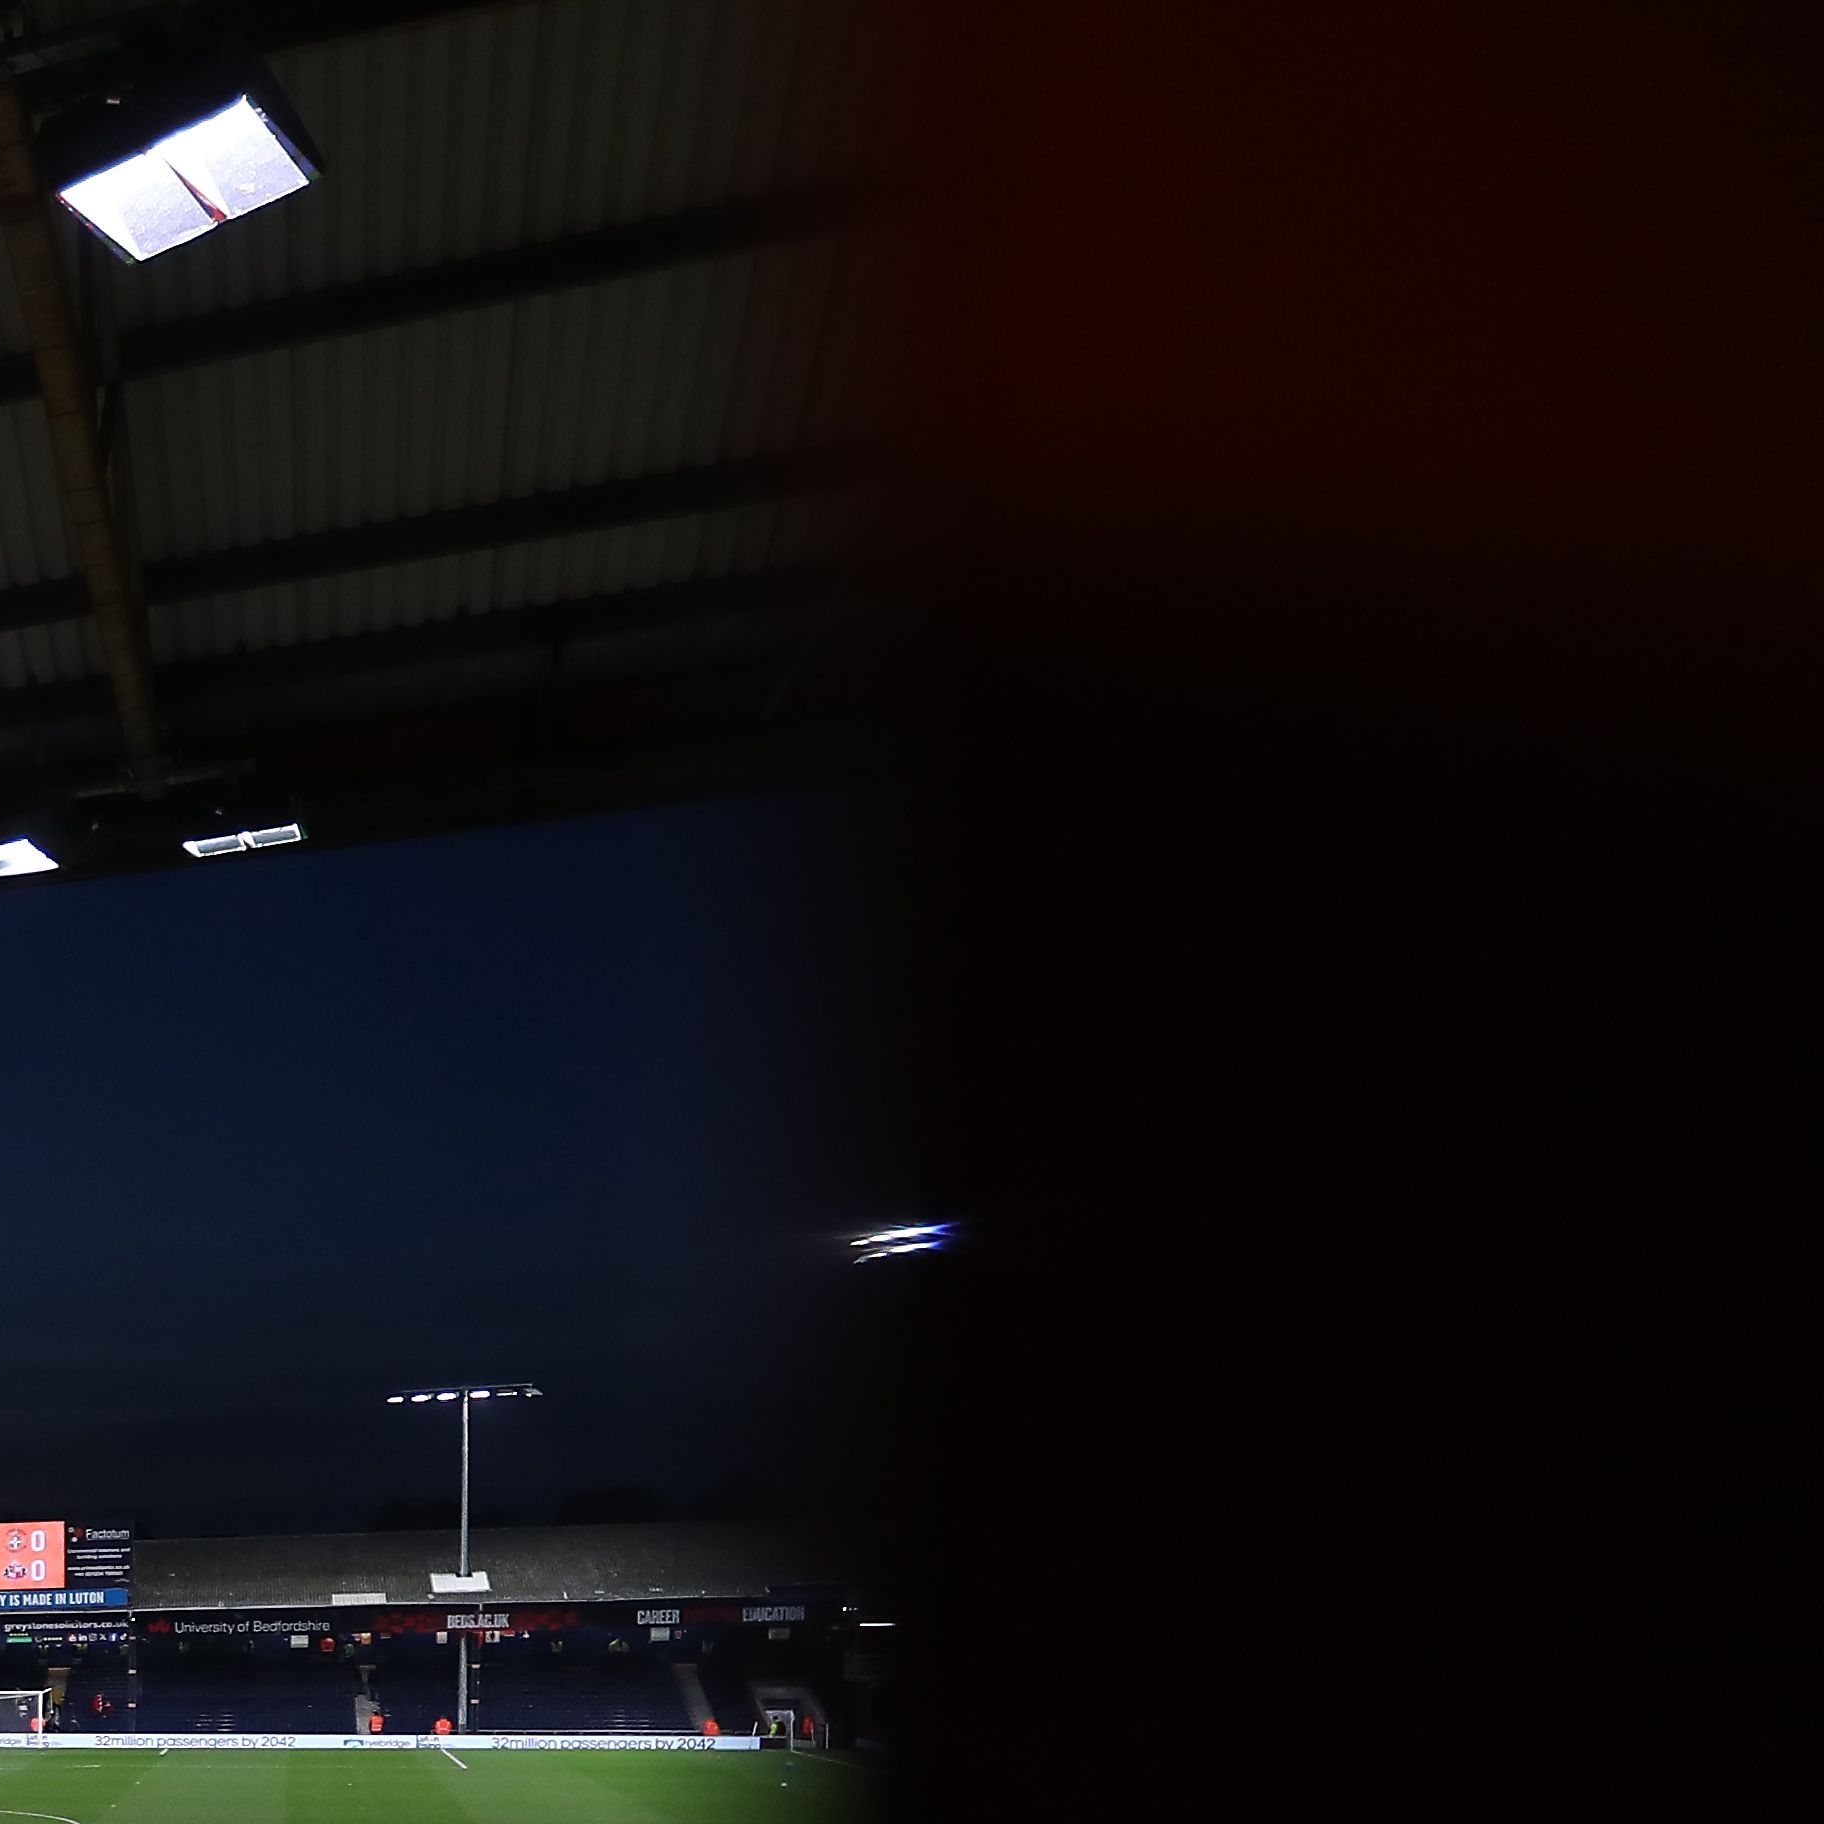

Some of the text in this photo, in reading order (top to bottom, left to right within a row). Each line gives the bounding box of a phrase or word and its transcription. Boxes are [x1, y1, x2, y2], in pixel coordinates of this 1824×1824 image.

[31, 1530, 46, 1551] 0
[31, 1560, 46, 1581] 0
[9, 1594, 19, 1606] IS
[24, 1594, 52, 1606] MADE
[56, 1593, 66, 1605] IN
[70, 1592, 104, 1604] LUTON
[447, 1614, 510, 1628] BEDS.AC.UK
[637, 1609, 680, 1625] CAREER
[742, 1606, 804, 1622] EDUCATION
[4, 1620, 129, 1632] greystonesolicitors.co.uk
[174, 1620, 330, 1634] University of Bedfordshire
[95, 1735, 296, 1749] 32million passengers by 2042
[491, 1737, 715, 1750] 32million passengers by 2042
